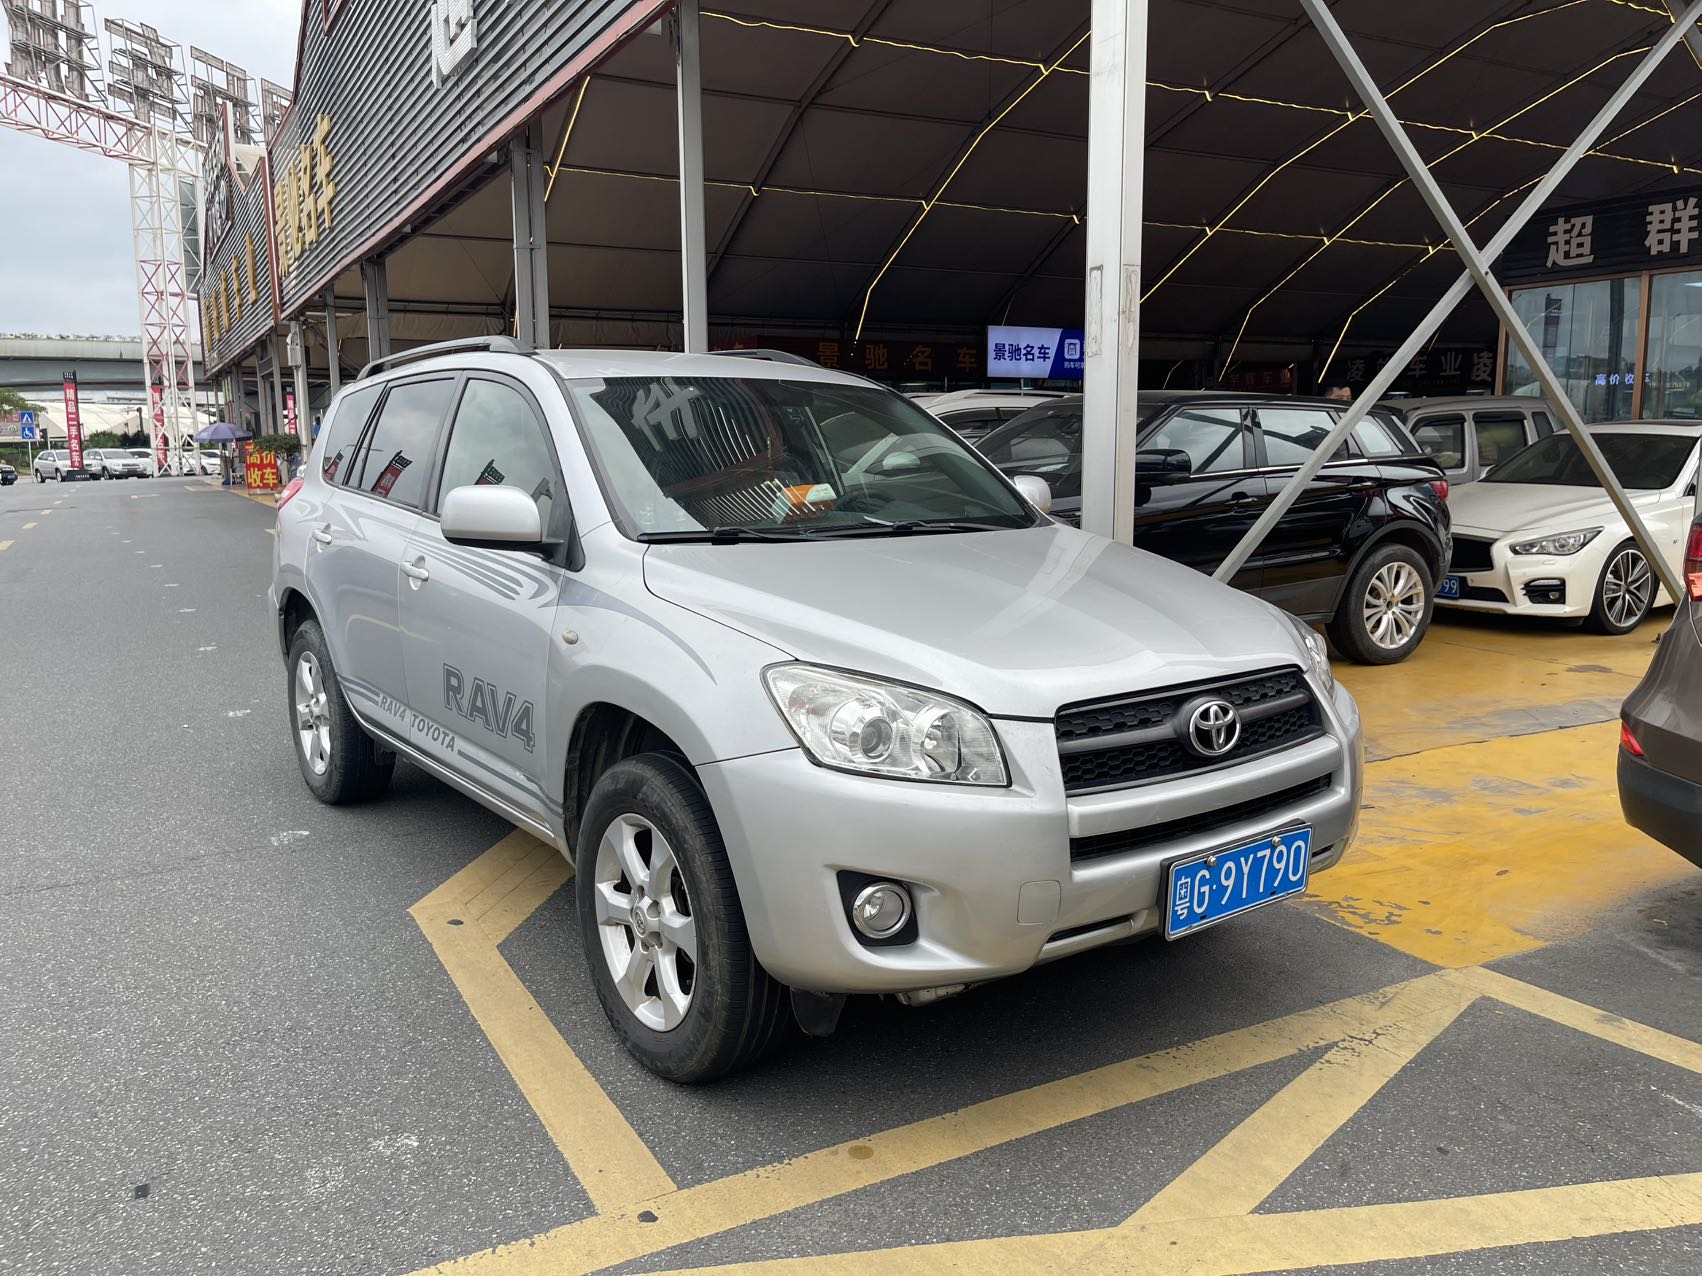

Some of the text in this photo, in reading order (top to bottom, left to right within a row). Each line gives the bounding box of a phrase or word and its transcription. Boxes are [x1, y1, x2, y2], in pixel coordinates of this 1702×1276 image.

[1545, 197, 1700, 268] 超群
[817, 341, 977, 370] 景驰名车
[993, 343, 1051, 362] 景驰名车
[66, 388, 80, 465] 精品二手名车
[247, 467, 278, 487] 收车
[379, 695, 455, 752] RAV4 TOYOTA
[443, 663, 535, 753] RAV4
